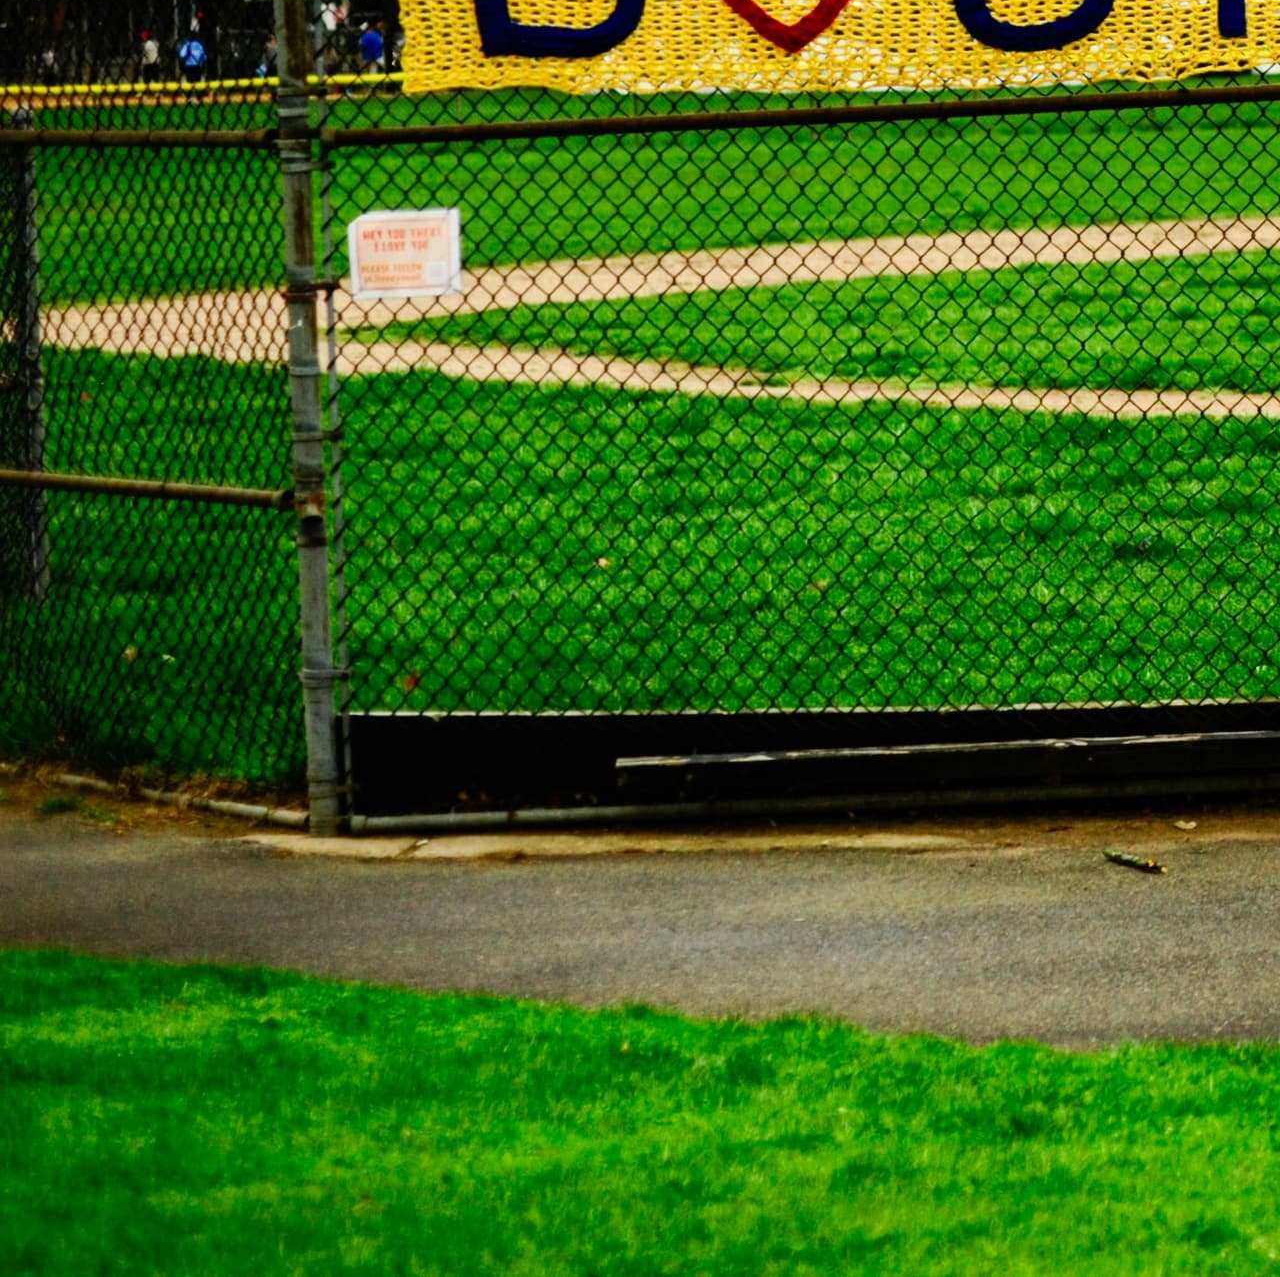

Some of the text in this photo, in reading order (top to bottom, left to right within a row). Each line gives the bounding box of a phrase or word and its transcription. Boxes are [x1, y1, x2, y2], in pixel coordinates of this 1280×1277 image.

[387, 228, 405, 239] YOU
[382, 241, 405, 251] LOVE
[412, 241, 428, 250] YOU
